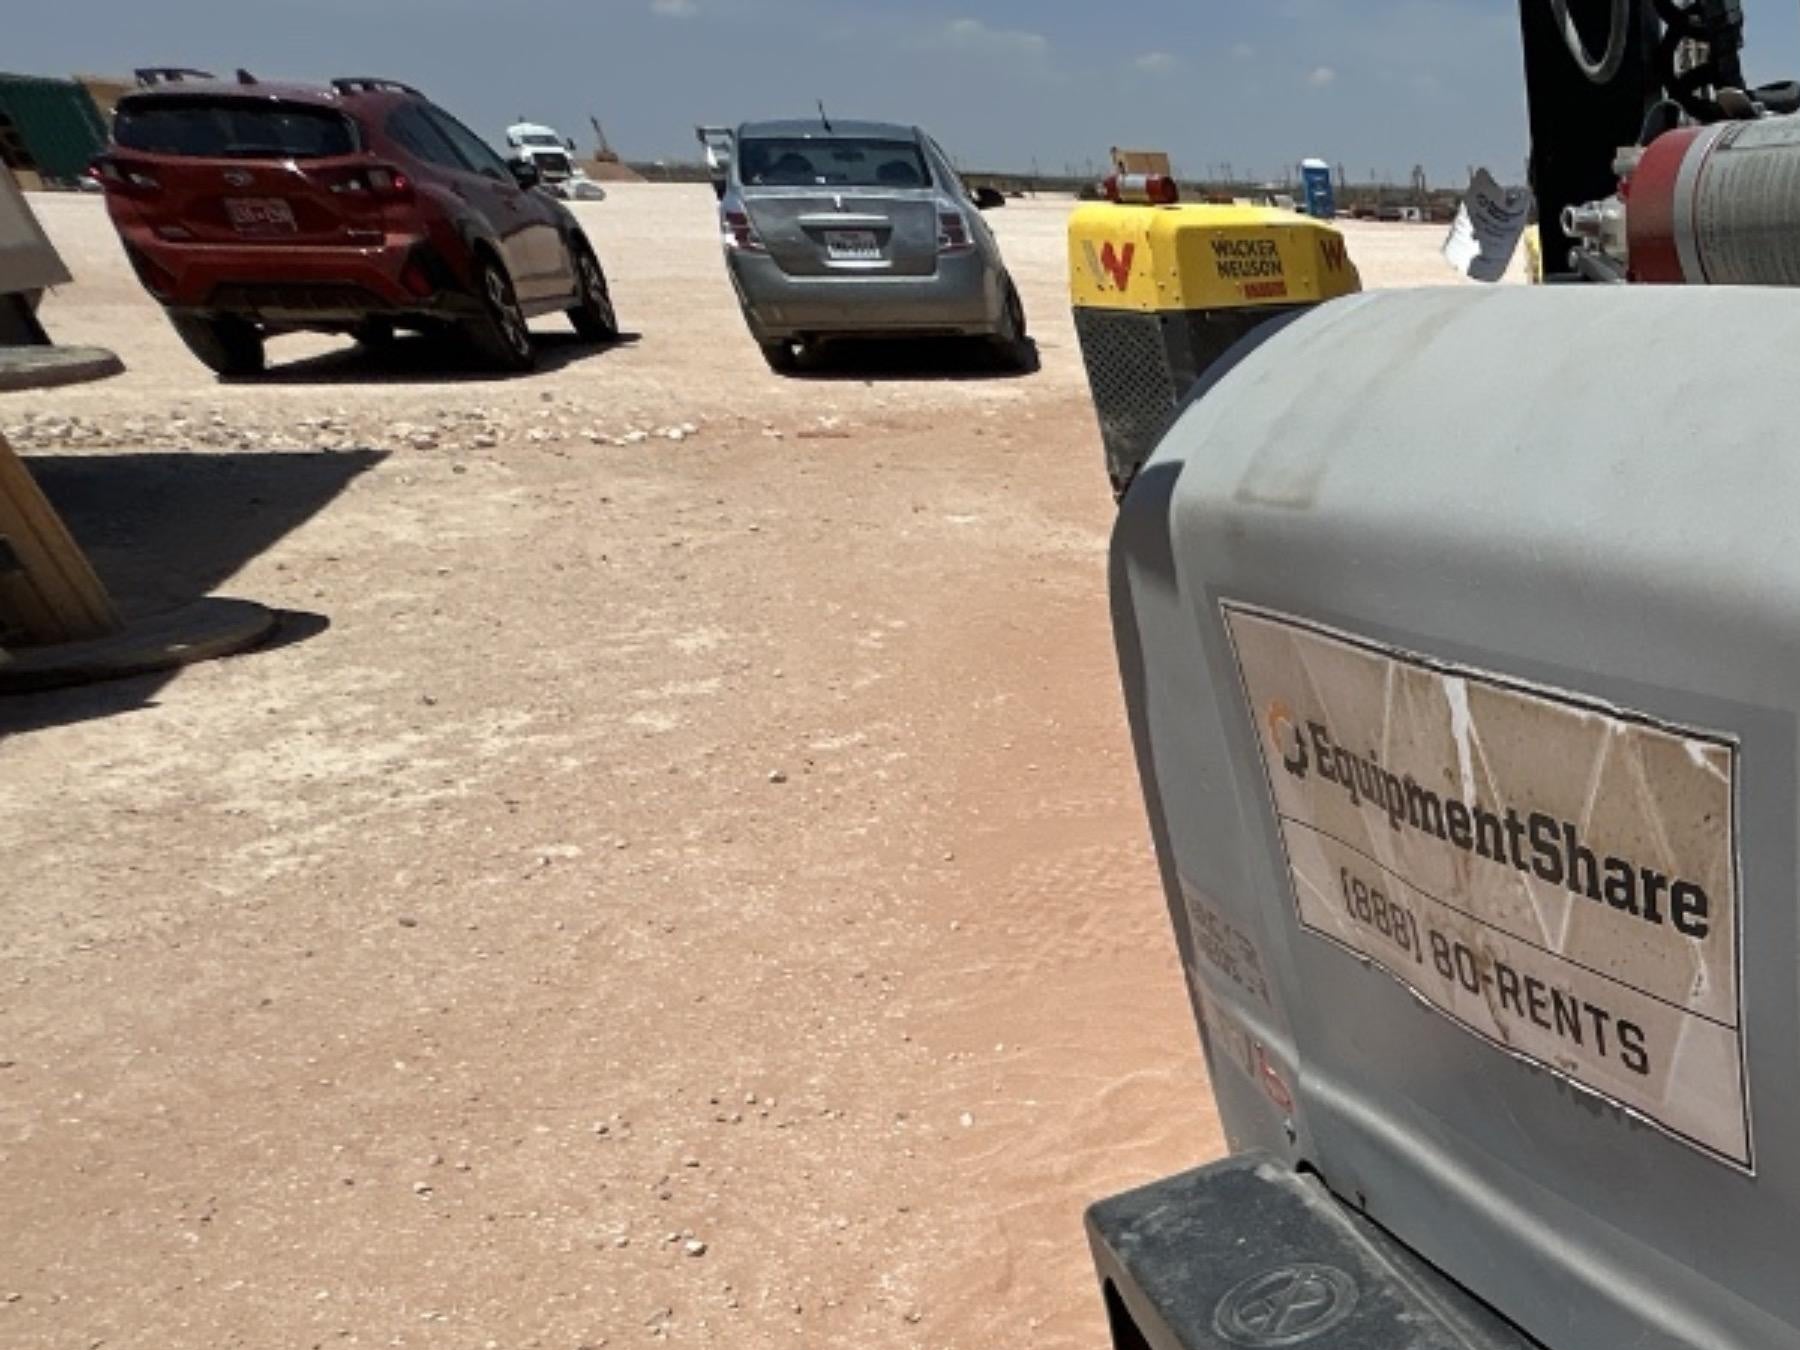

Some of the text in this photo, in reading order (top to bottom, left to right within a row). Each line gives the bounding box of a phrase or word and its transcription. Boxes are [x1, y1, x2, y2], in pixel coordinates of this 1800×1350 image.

[1211, 239, 1279, 258] WACKER
[1216, 260, 1282, 278] NEUSON
[1305, 720, 1708, 939] EquipmentShare
[1340, 866, 1423, 964] (888)
[1430, 929, 1650, 1075] 80-RENTS
